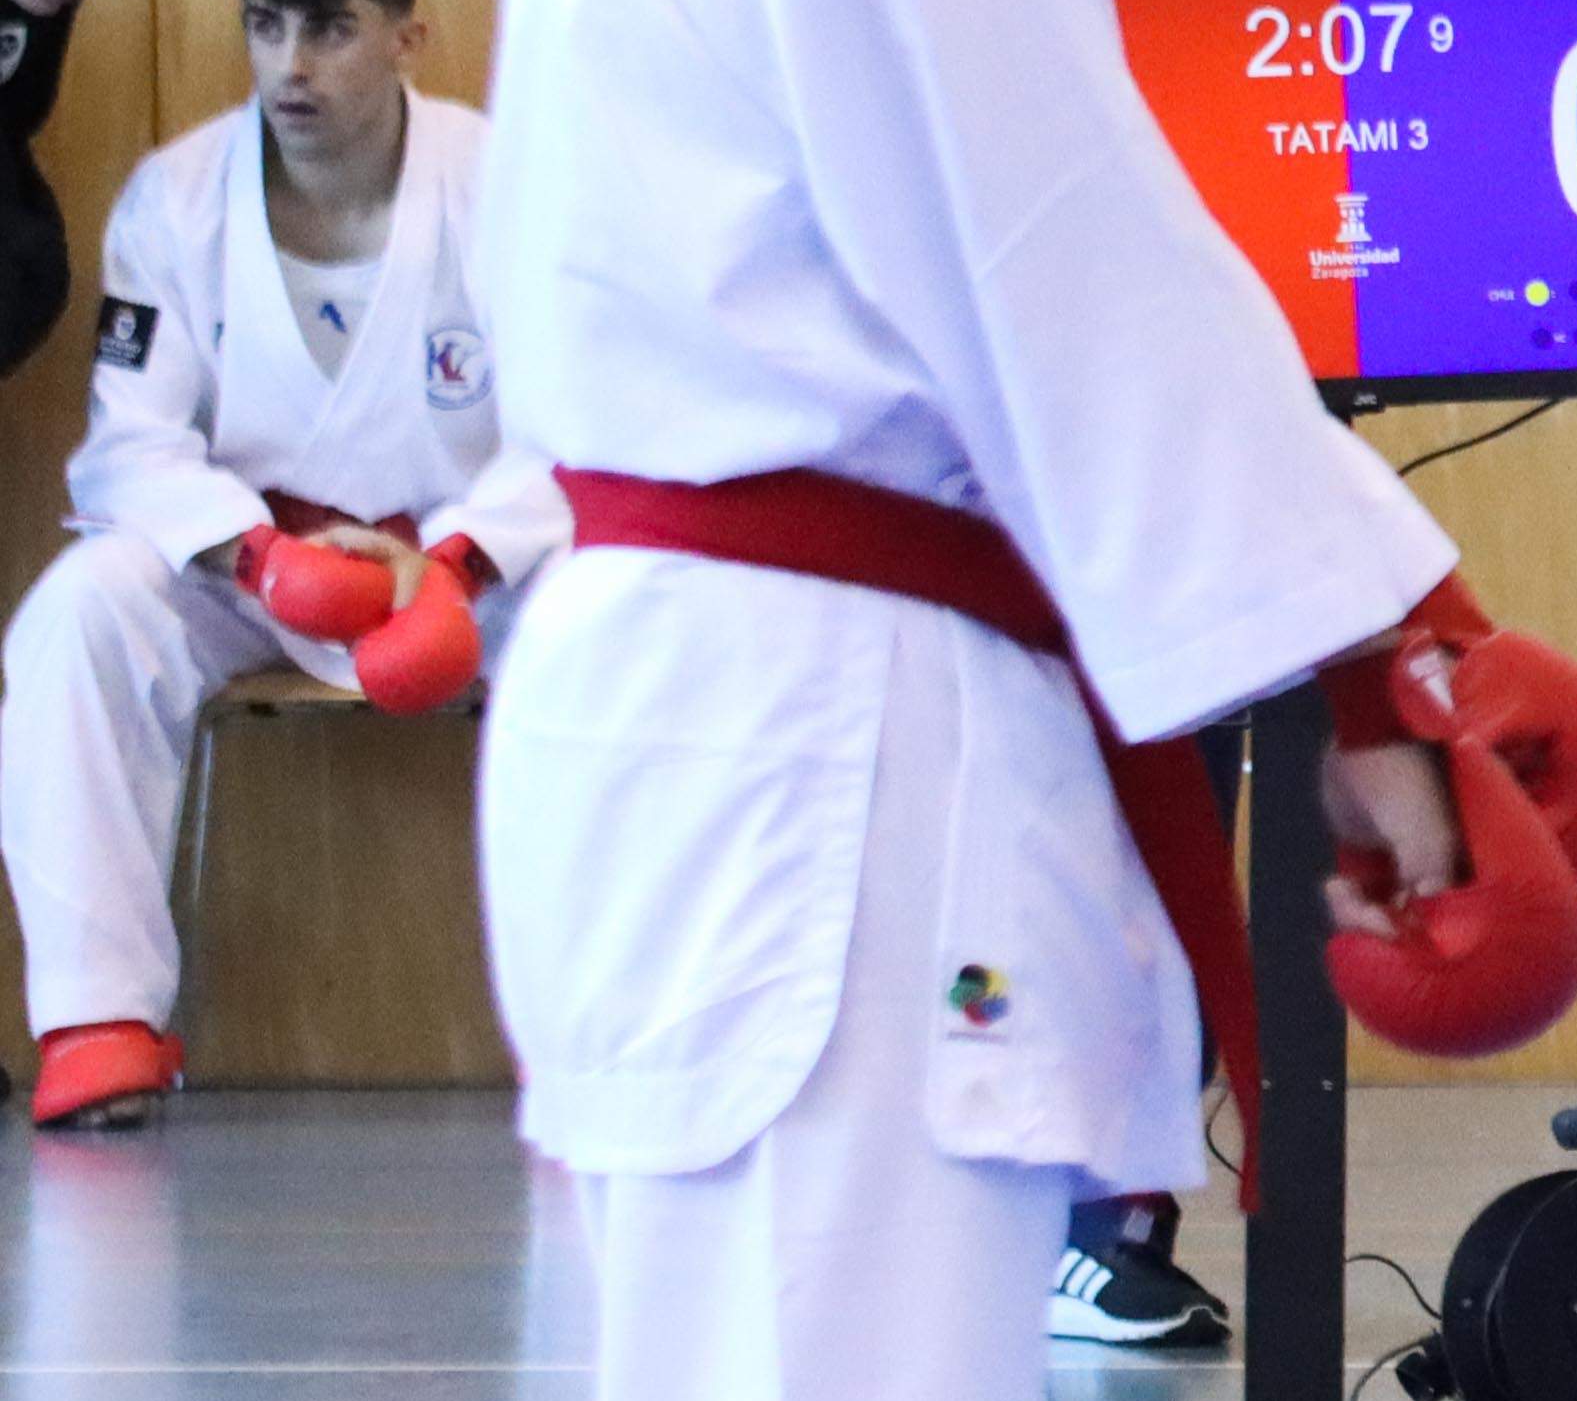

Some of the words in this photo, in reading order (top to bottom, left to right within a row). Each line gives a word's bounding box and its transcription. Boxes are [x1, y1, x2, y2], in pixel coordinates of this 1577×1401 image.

[1245, 3, 1413, 78] 2:07
[1428, 15, 1454, 53] 9
[1266, 119, 1398, 156] TATAMI
[1408, 119, 1429, 151] 3
[1309, 248, 1400, 266] Universidad
